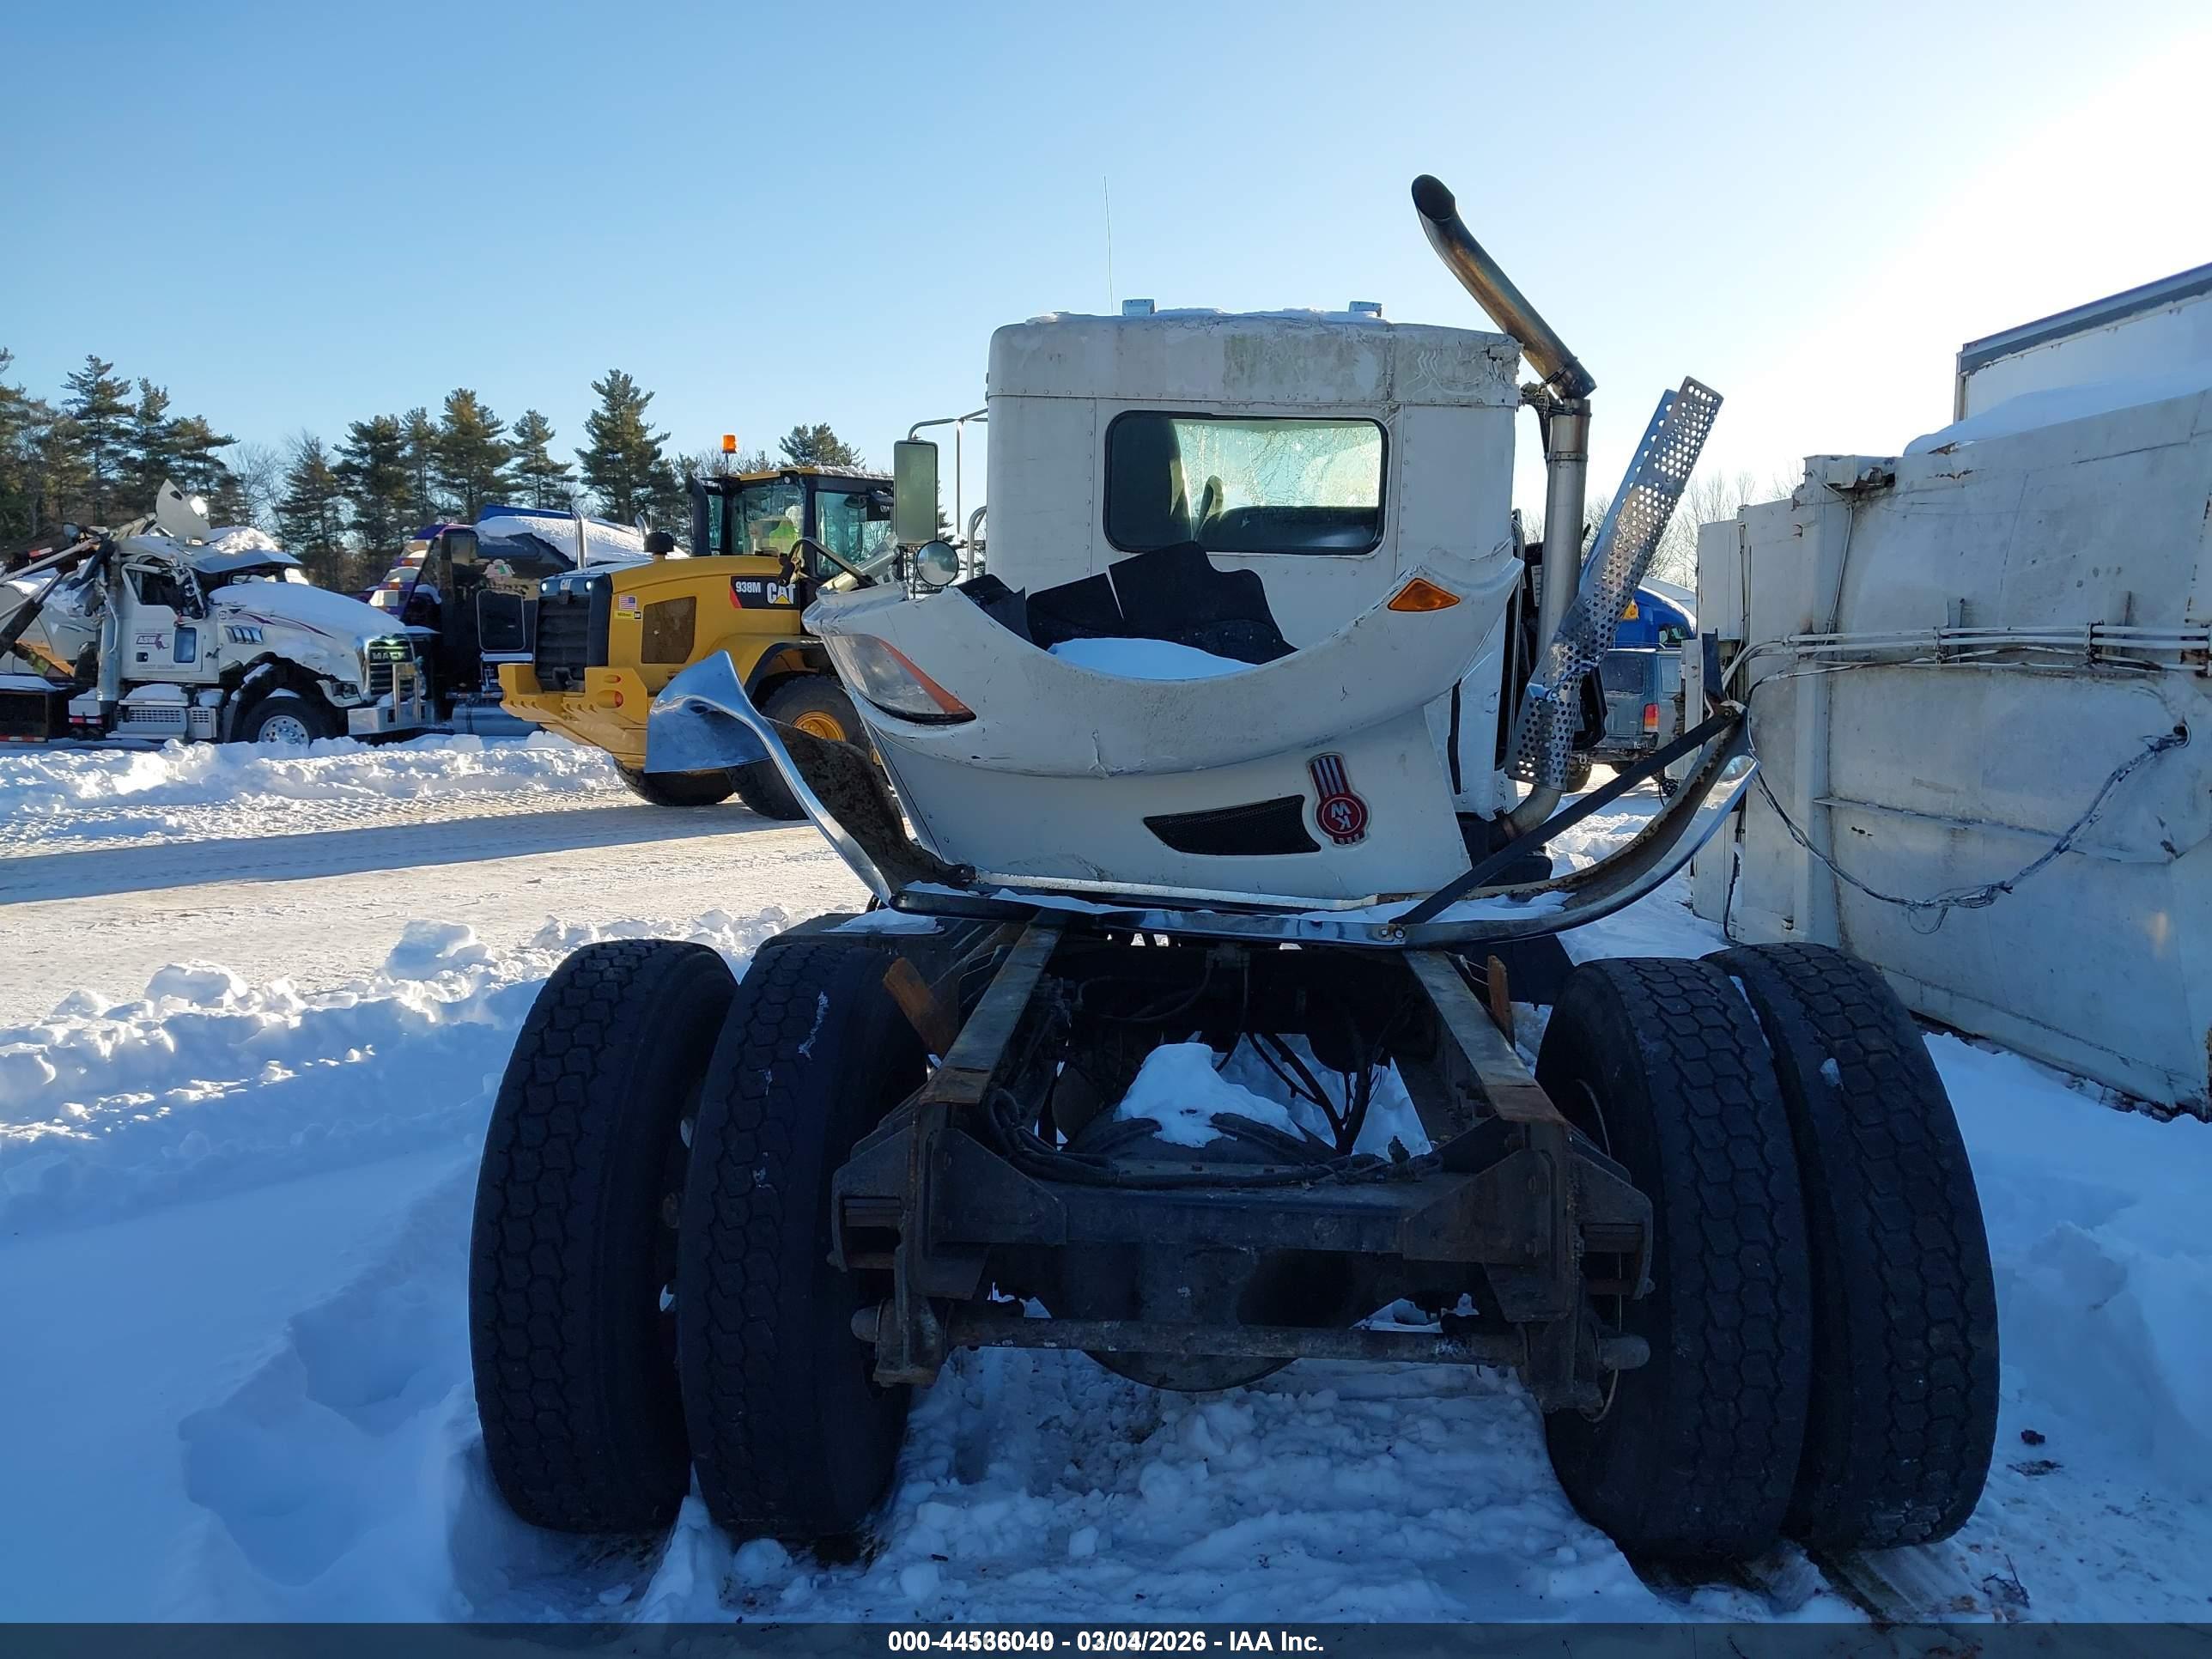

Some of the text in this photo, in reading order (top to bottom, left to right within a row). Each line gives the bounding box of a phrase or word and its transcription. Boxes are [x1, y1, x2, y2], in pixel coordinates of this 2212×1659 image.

[560, 578, 573, 591] CAT
[735, 581, 762, 593] 938M
[767, 582, 796, 605] CAT
